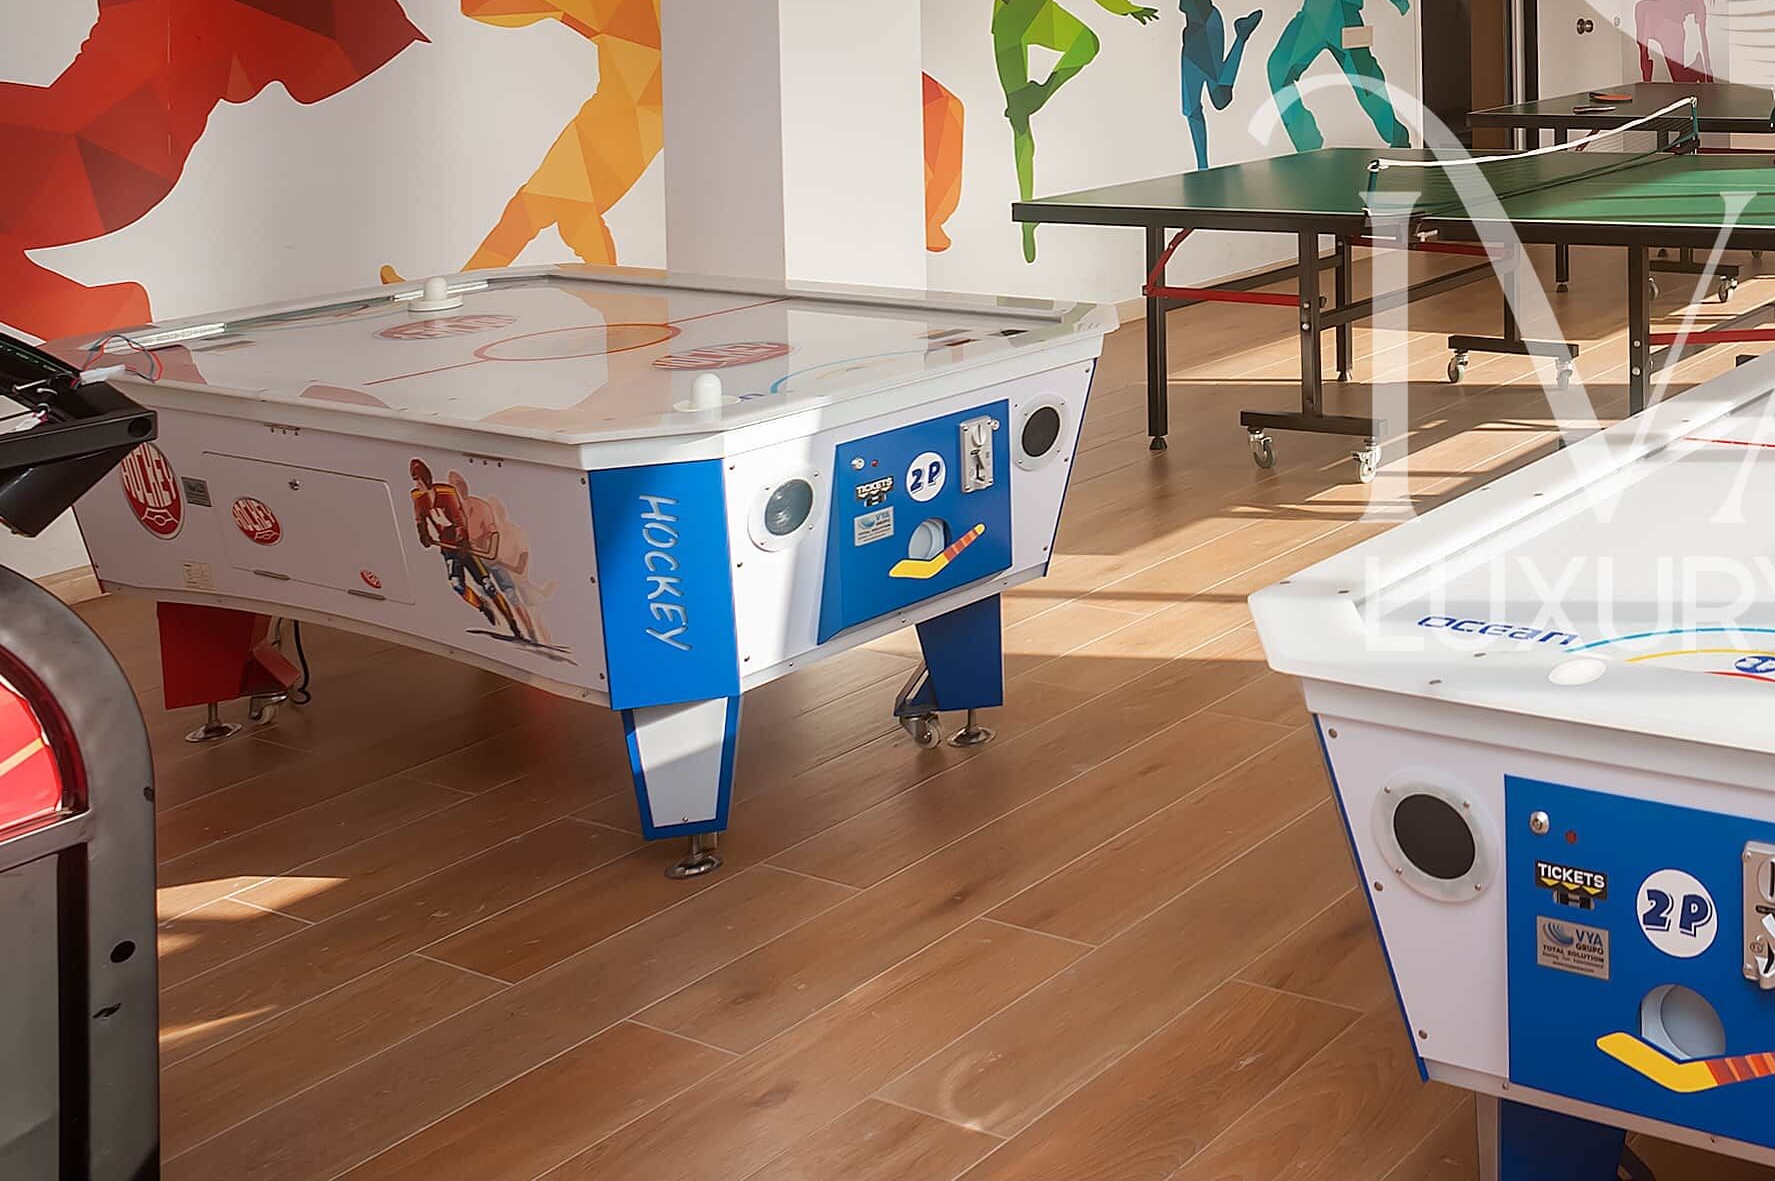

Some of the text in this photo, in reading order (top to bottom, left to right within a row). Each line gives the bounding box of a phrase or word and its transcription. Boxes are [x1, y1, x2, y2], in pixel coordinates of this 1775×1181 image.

[121, 442, 177, 508] HOCKEY
[856, 477, 893, 495] TICKETS
[639, 494, 693, 651] HOCKEY
[1537, 863, 1606, 889] TICKETS
[1576, 928, 1604, 947] VYA
[1576, 942, 1604, 956] GRUPO
